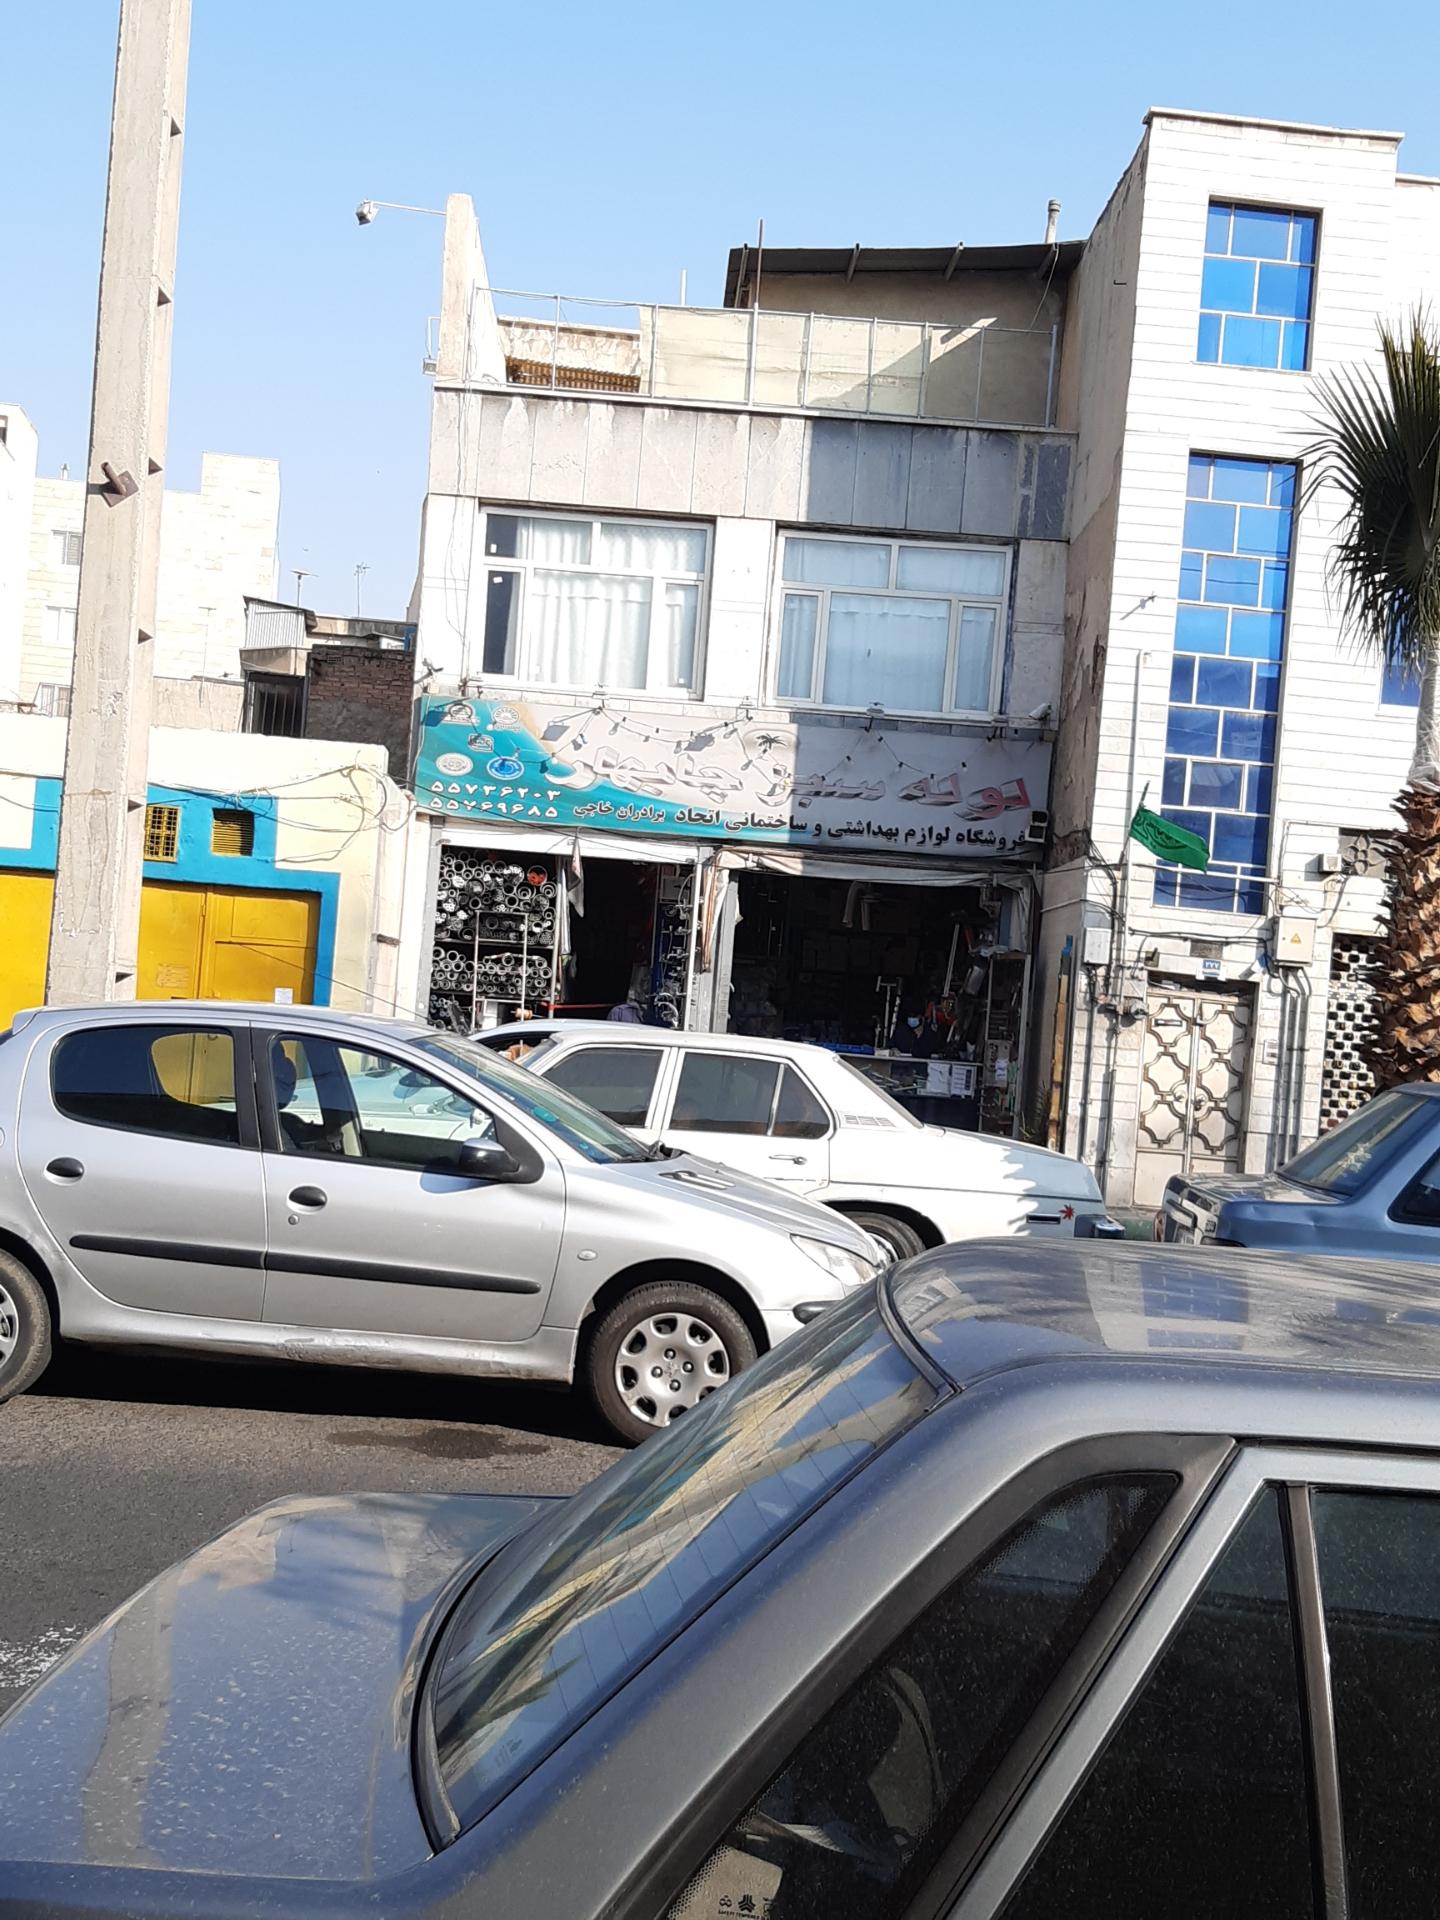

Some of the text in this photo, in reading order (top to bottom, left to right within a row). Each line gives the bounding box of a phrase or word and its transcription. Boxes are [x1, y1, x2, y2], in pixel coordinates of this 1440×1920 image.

[545, 745, 743, 805] چابهار
[896, 770, 1031, 822] لوله
[616, 804, 665, 823] برادران
[675, 807, 721, 827] اتحاد
[725, 811, 808, 832] ساختمانی
[813, 823, 822, 837] و
[828, 819, 900, 846] بهداشتی
[903, 825, 951, 847] لوازم
